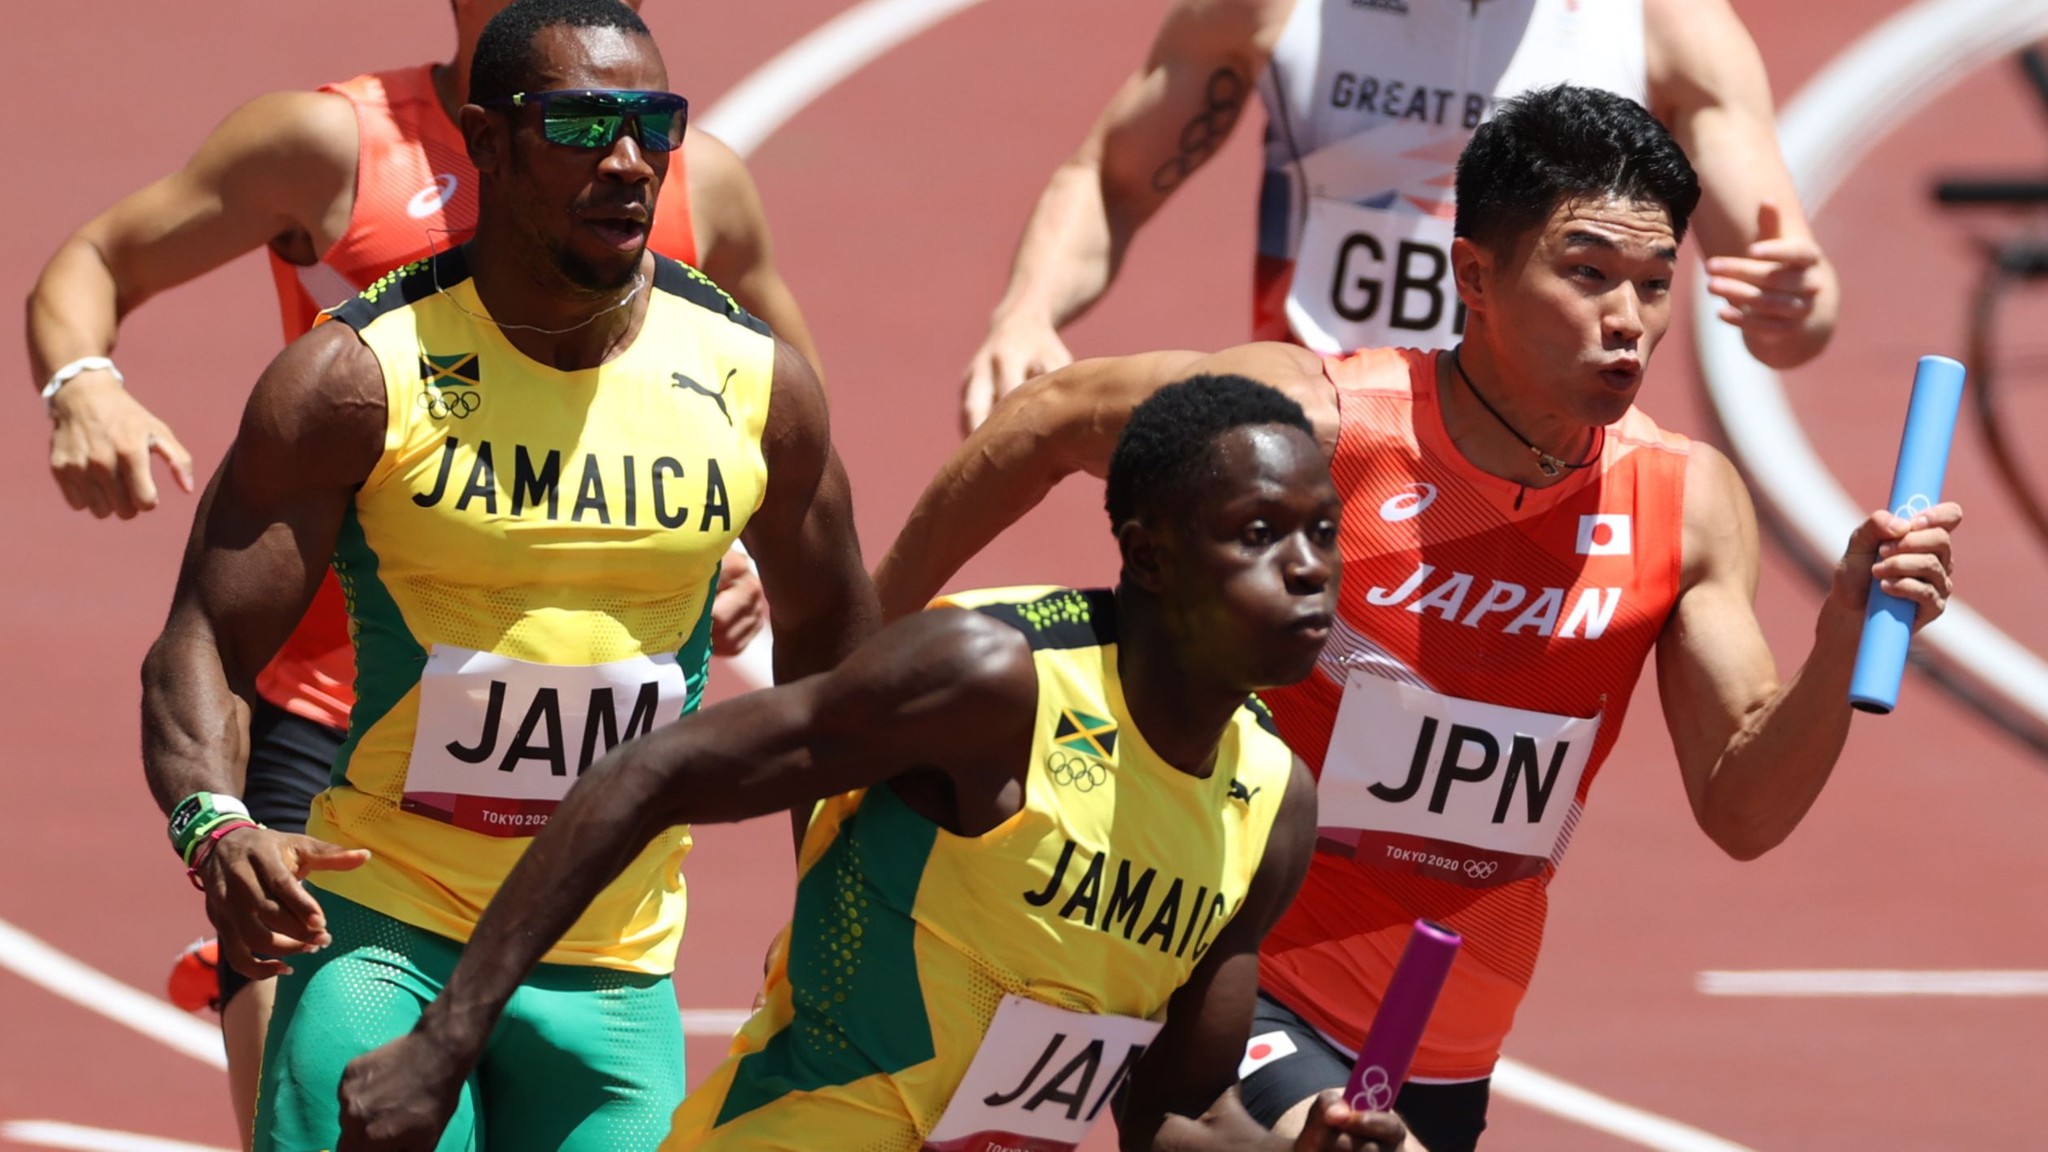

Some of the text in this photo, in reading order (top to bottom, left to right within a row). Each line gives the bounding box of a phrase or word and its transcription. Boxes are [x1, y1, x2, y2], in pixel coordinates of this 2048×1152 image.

[1331, 71, 1455, 125] GREAT
[1331, 232, 1466, 335] GB
[411, 436, 731, 532] JAMAICA
[1366, 561, 1623, 641] JAPAN
[1366, 715, 1571, 824] JPN
[482, 809, 552, 826] TOKYO 202
[1386, 845, 1459, 871] TOKYO 2020
[1023, 839, 1241, 962] JAMAIC
